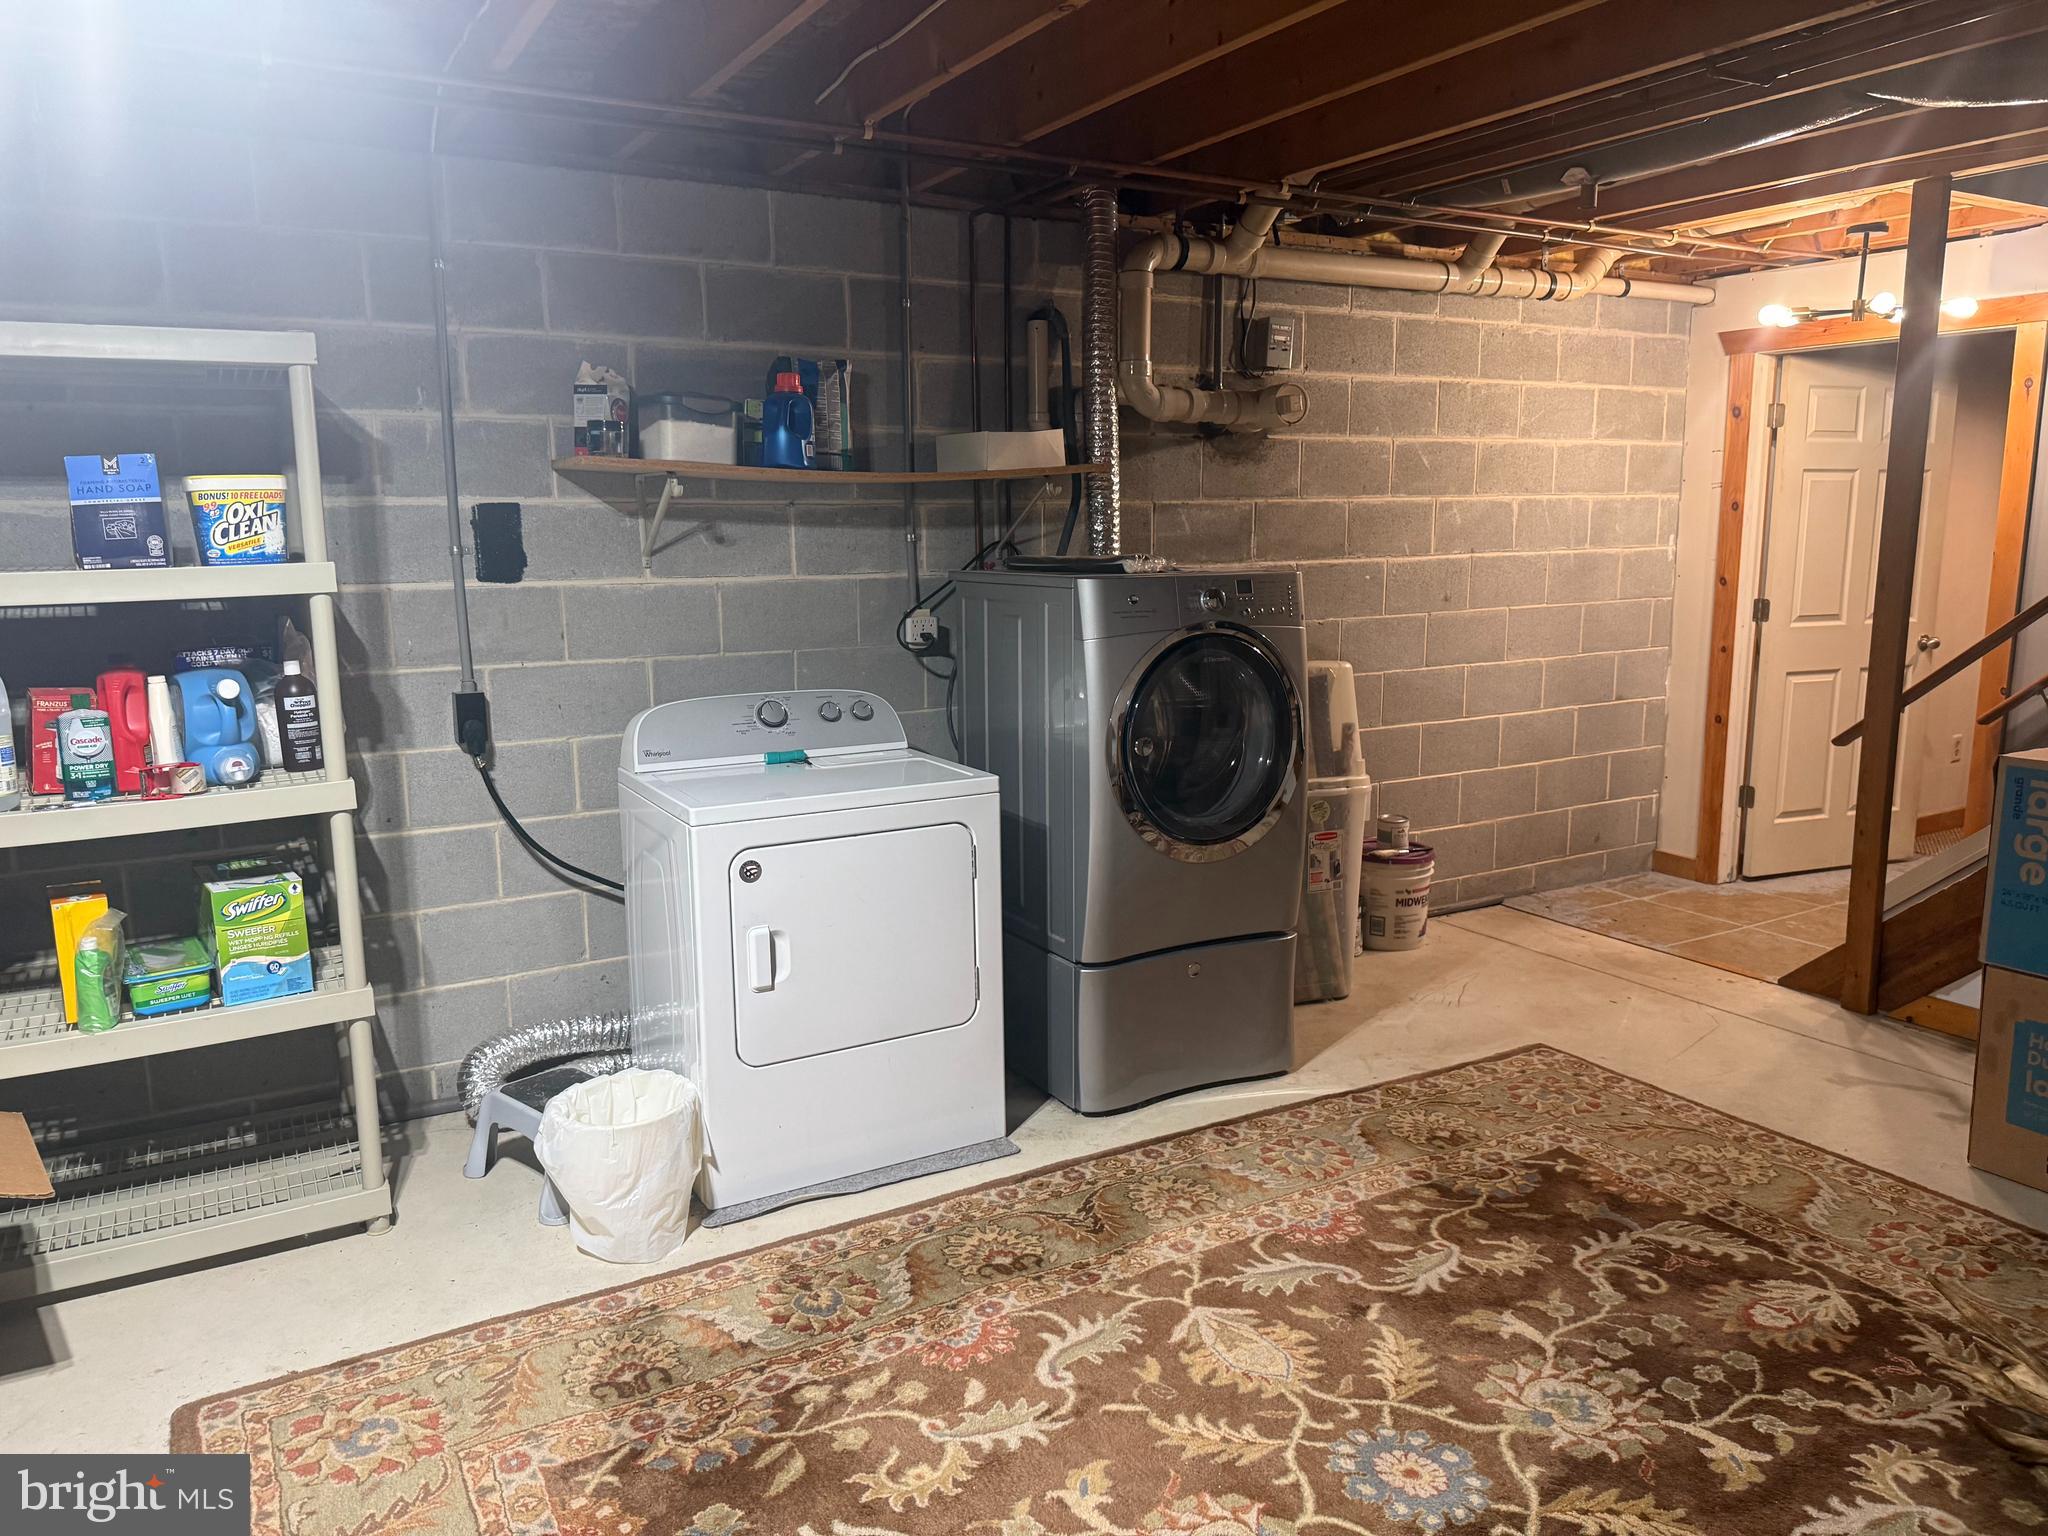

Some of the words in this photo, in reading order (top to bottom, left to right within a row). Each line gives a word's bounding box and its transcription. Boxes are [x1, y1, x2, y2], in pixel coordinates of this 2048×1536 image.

[76, 485, 113, 495] HAND
[119, 483, 152, 493] SOAP
[198, 492, 229, 501] BONUS!
[231, 492, 238, 500] 10
[240, 491, 259, 499] FREE
[226, 500, 264, 525] OXI
[213, 511, 278, 546] CLEAN
[228, 537, 261, 551] VERSATILE
[185, 655, 214, 663] STAINS
[70, 736, 102, 745] Cascade
[642, 749, 671, 758] Whirlpool
[2012, 776, 2024, 820] grande
[2014, 778, 2048, 886] large
[223, 892, 284, 921] Swiffer
[1395, 894, 1428, 908] MIDWE
[227, 925, 276, 939] SWEEPER
[274, 930, 300, 939] REFILLS
[269, 962, 279, 970] 60
[155, 981, 188, 994] Swiffer
[150, 995, 181, 1005] SWEEPER
